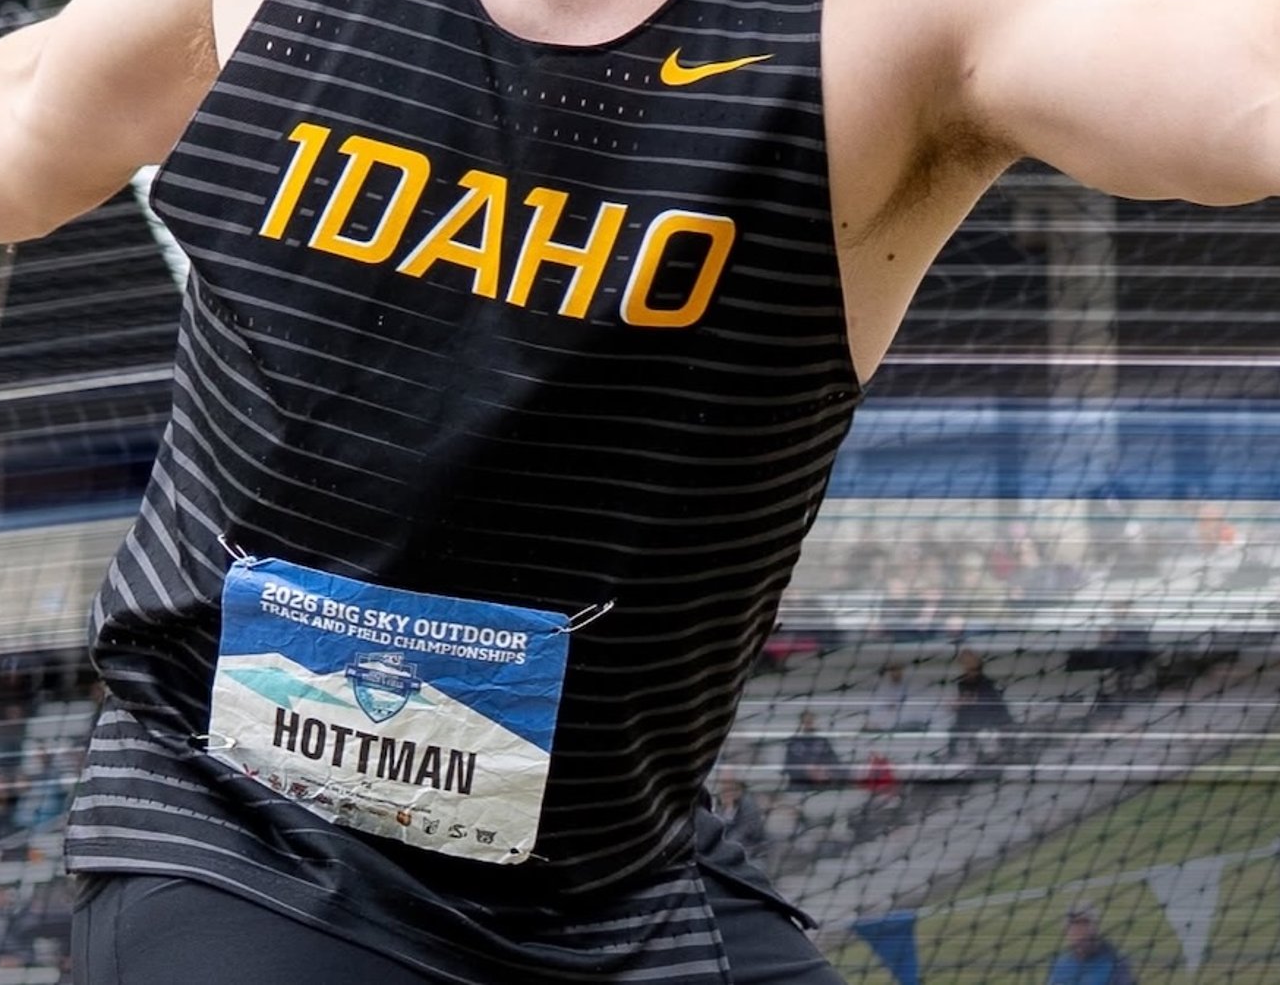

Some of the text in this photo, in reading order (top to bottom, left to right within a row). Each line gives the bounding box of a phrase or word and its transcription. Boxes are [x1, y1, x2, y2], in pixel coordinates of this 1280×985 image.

[259, 122, 736, 328] IDAHO
[260, 600, 309, 625] TRACK
[311, 616, 345, 634] AND
[347, 624, 391, 645] FIELD
[393, 635, 527, 665] CHAMPIONSHIPS
[261, 582, 528, 650] 2026 BIG SKY OUTDOOR
[273, 707, 478, 795] HOTTMAN
